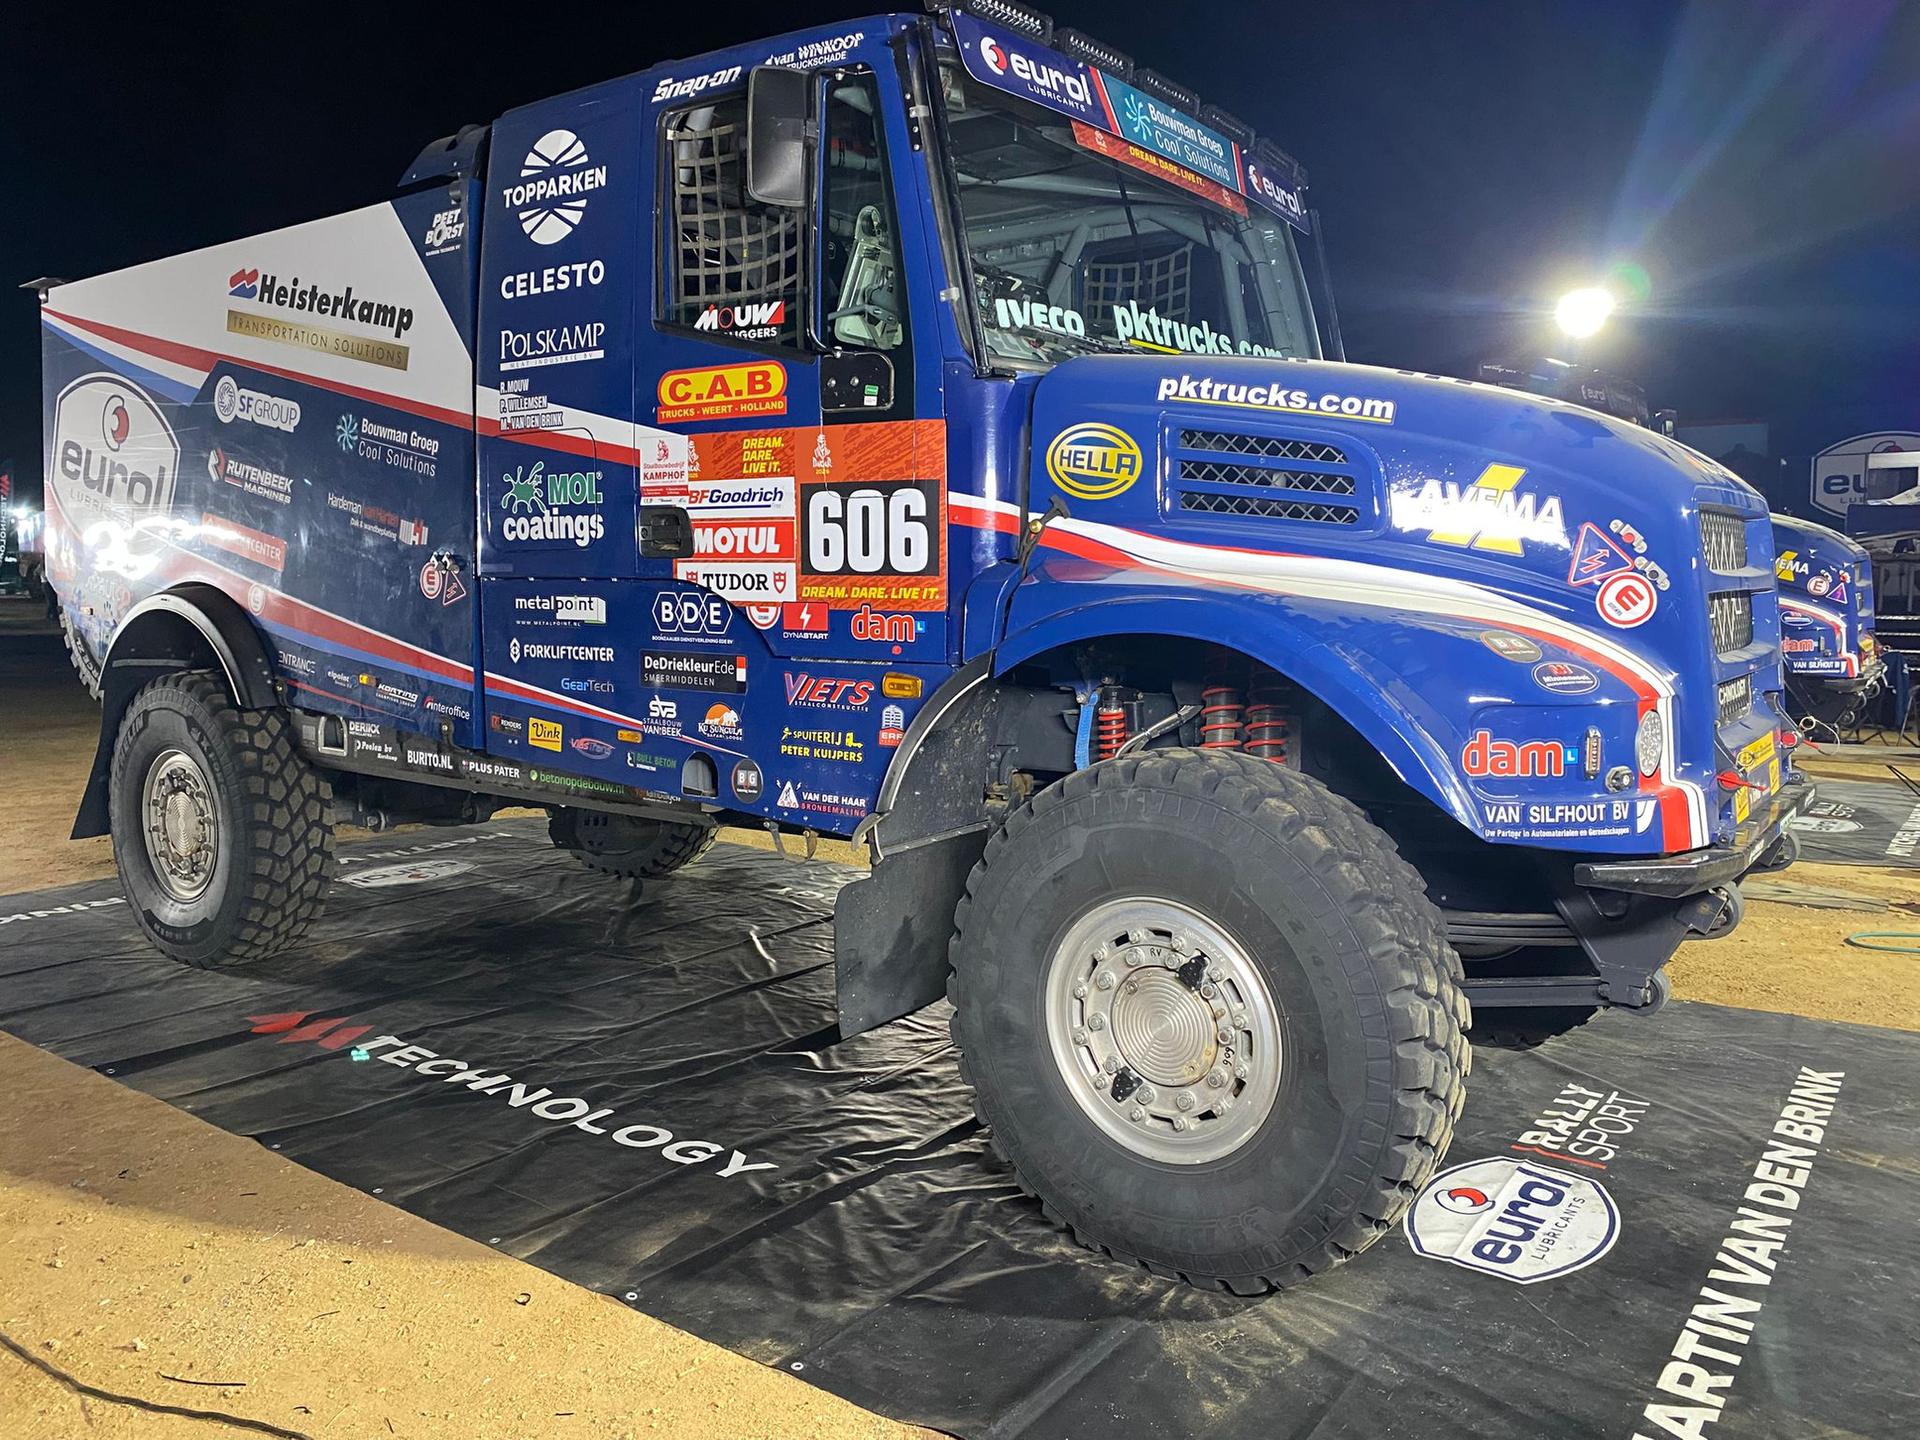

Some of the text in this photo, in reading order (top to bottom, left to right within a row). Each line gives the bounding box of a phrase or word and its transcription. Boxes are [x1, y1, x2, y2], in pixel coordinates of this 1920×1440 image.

[651, 66, 742, 103] Snap-on
[1010, 52, 1092, 105] eurol
[1028, 83, 1086, 113] LUBRICANTS
[1149, 103, 1224, 158] Bouwman Groep
[1129, 146, 1159, 167] DREAM.
[1159, 159, 1180, 176] DARE.
[1155, 130, 1230, 182] Cool Solutions
[503, 166, 607, 208] TOPPARKEN
[1263, 177, 1301, 216] eurol
[432, 208, 461, 228] PEET
[501, 260, 605, 299] CELESTO
[258, 274, 413, 338] Heisterkamp
[694, 301, 782, 331] MOUW
[996, 299, 1084, 336] IVECO
[232, 316, 402, 364] TRANSPORTATION SOLUTIONS
[501, 323, 605, 359] POLSKAMP
[508, 396, 548, 412] WILLEMSEN
[660, 401, 785, 419] TRUCKS WEERT HOLLAND
[1158, 375, 1395, 419] pktrucks.com
[512, 415, 525, 429] VAN
[527, 414, 540, 428] DEN
[541, 412, 563, 428] BRINK
[361, 418, 439, 455] Bouwman Groep
[742, 437, 784, 449] DREAM.
[358, 442, 436, 477] Cool Solutions
[742, 462, 781, 474] LIVE IT.
[743, 450, 774, 461] DARE.
[1060, 449, 1136, 476] HELLA
[61, 440, 166, 505] eurol
[226, 460, 293, 493] RUITENBEEK
[643, 471, 685, 480] KAMPHOF
[244, 482, 291, 504] MACHINES
[328, 492, 362, 515] Hardeman
[548, 472, 603, 505] MOL
[688, 487, 783, 504] BFGoodrich
[503, 507, 604, 547] coatings
[693, 527, 781, 554] MOTUL
[808, 488, 929, 573] 606
[703, 573, 769, 591] TUDOR
[802, 586, 940, 599] DREAM. DARE. LIVE IT.
[515, 595, 594, 613] metalpoint
[783, 632, 828, 640] DYNASTART
[852, 605, 915, 643] dam
[279, 651, 316, 674] ENTRANCE
[524, 644, 614, 661] FORKLIFTCENTER
[644, 673, 715, 686] SMEERMIDDELEN
[784, 672, 874, 706] VIETS
[532, 722, 560, 740] Vink
[793, 730, 841, 746] SPUITERIJ
[407, 750, 453, 770] BURITO.NL
[781, 745, 863, 762] PETER KUIJPERS
[1463, 728, 1564, 777] dam
[469, 761, 520, 779] PLUS PATER
[539, 772, 625, 795] betonopdebouw.nl
[802, 791, 866, 808] VAN DER HAAR
[1485, 802, 1629, 823] VAN SILFHOUT BV
[355, 1035, 779, 1179] TECHNOLOGY
[1517, 1082, 1605, 1150] RALLY
[1568, 1091, 1650, 1161] SPORT
[1472, 1165, 1573, 1265] eurol
[1530, 1196, 1587, 1262] LUBRICANTS
[1631, 1065, 1846, 1440] ARTIN VAN DEN BRINK
